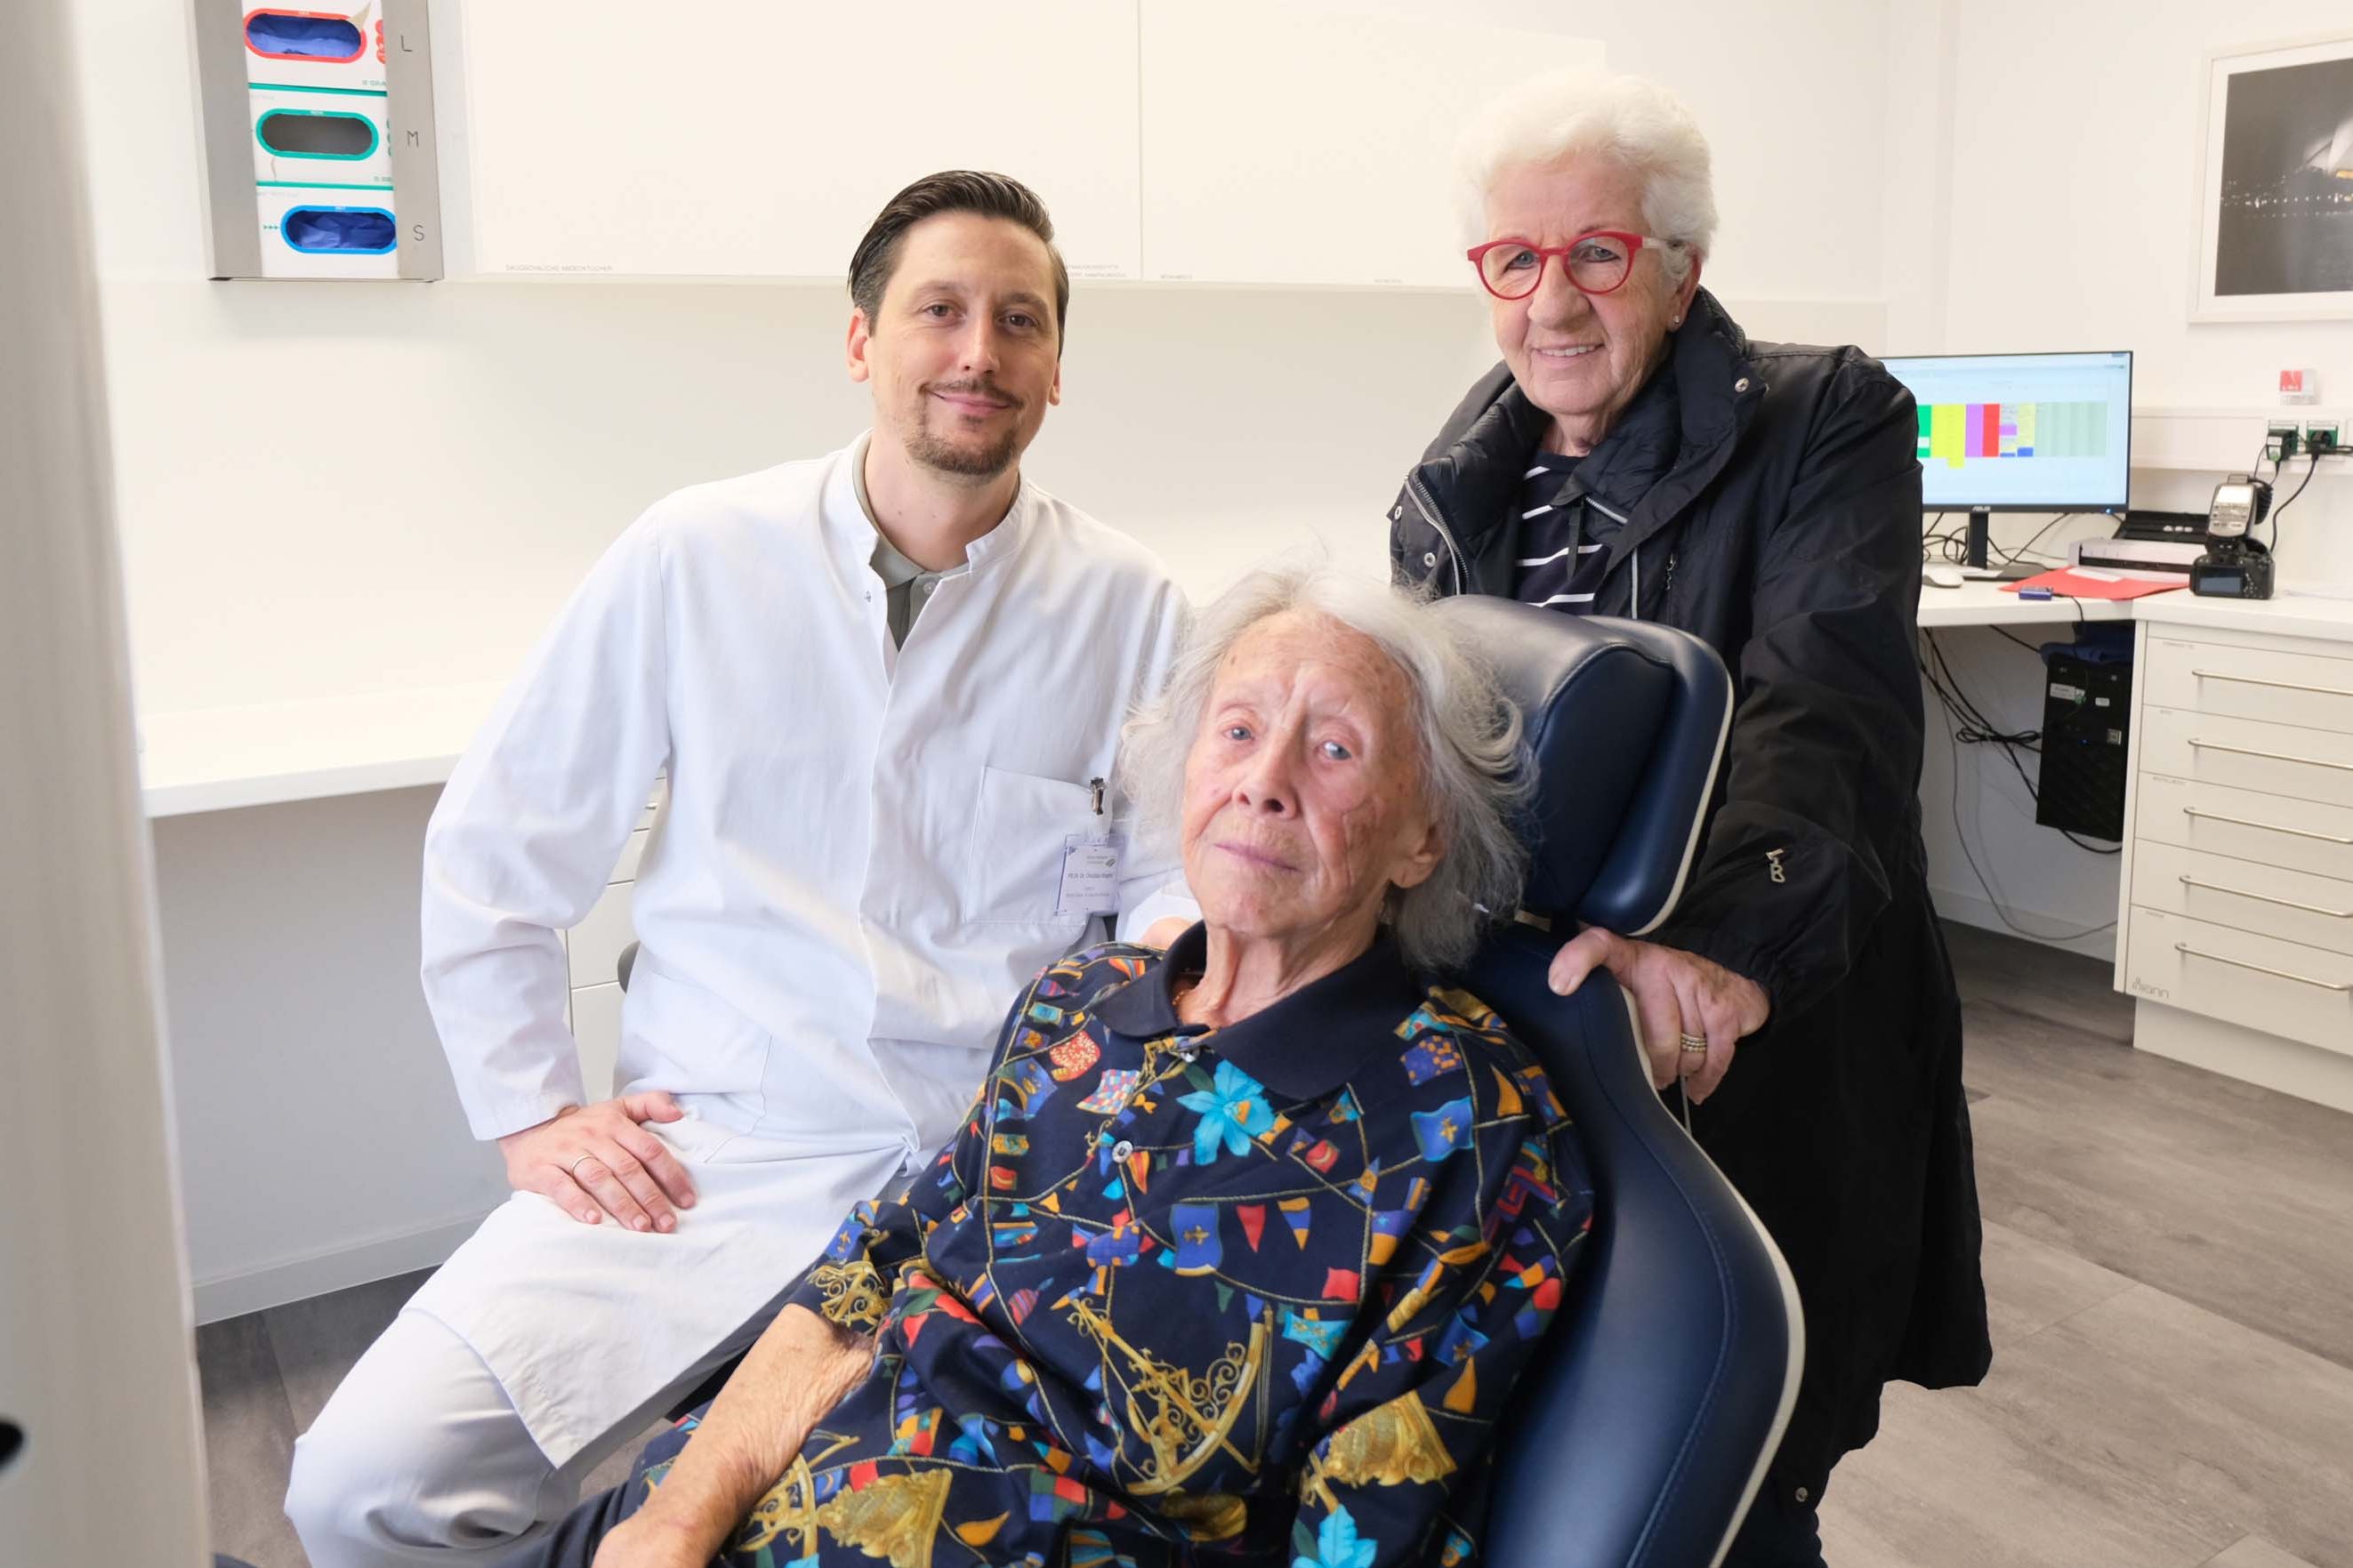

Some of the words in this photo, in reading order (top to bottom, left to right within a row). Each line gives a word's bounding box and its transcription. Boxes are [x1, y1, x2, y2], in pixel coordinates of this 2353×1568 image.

[400, 35, 413, 52] L
[407, 130, 420, 148] M
[413, 224, 425, 242] S
